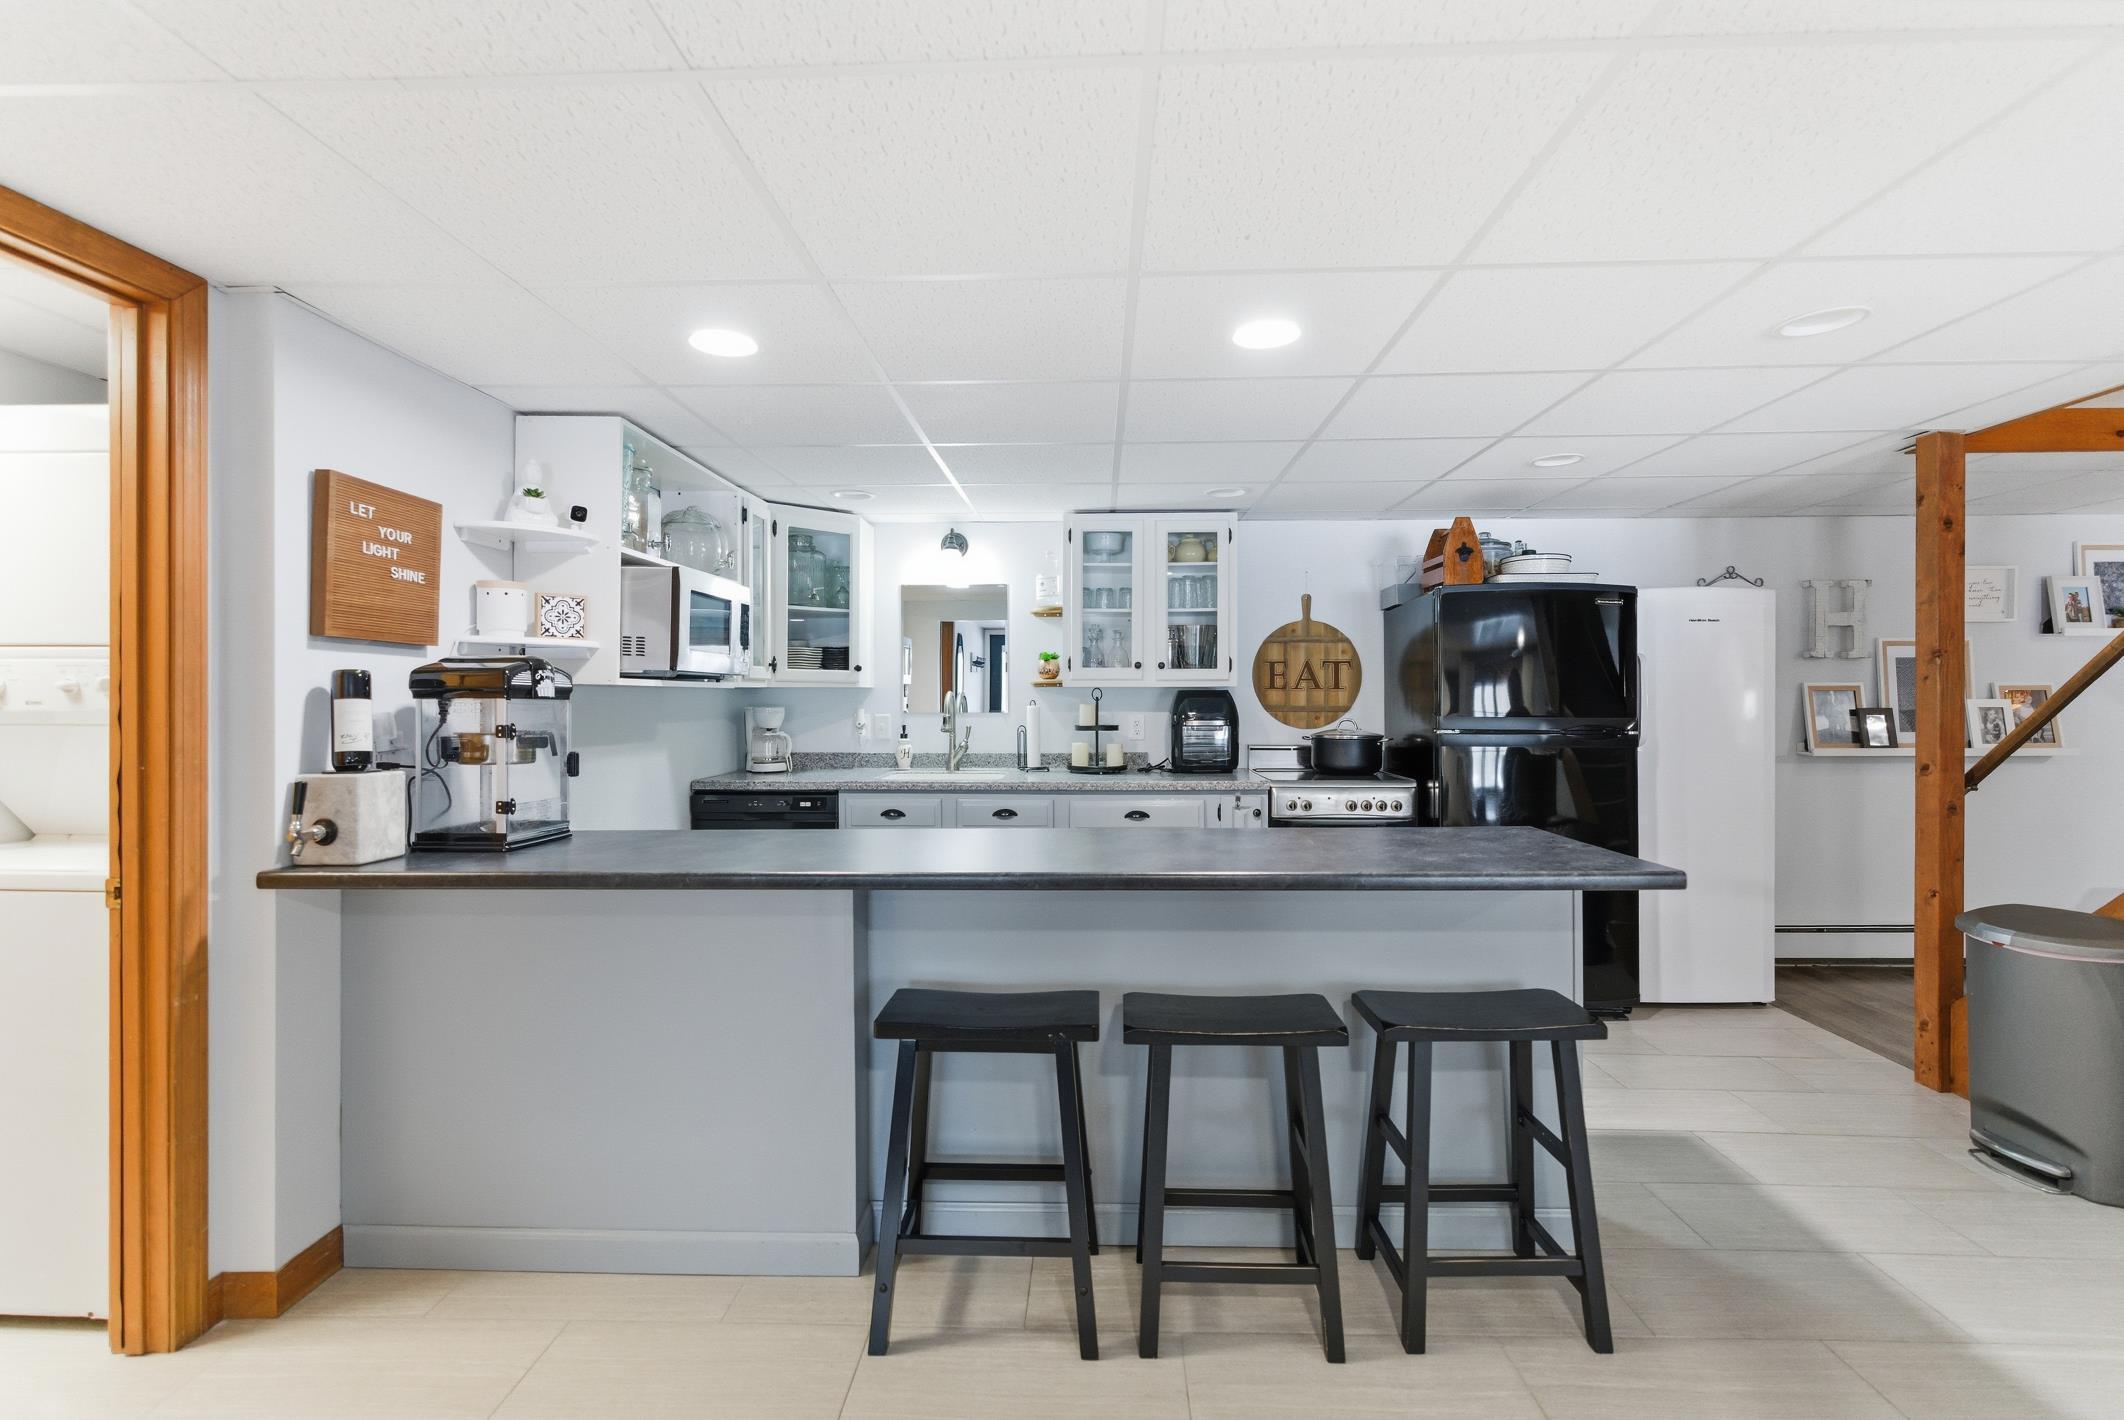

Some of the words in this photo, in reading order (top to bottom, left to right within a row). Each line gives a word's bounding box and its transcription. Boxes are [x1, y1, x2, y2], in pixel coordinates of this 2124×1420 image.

[349, 501, 376, 519] LET
[378, 526, 413, 544] YOUR
[362, 541, 400, 560] LIGHT
[390, 566, 426, 585] SHINE
[1801, 579, 1873, 660] H
[1264, 659, 1353, 690] EAT
